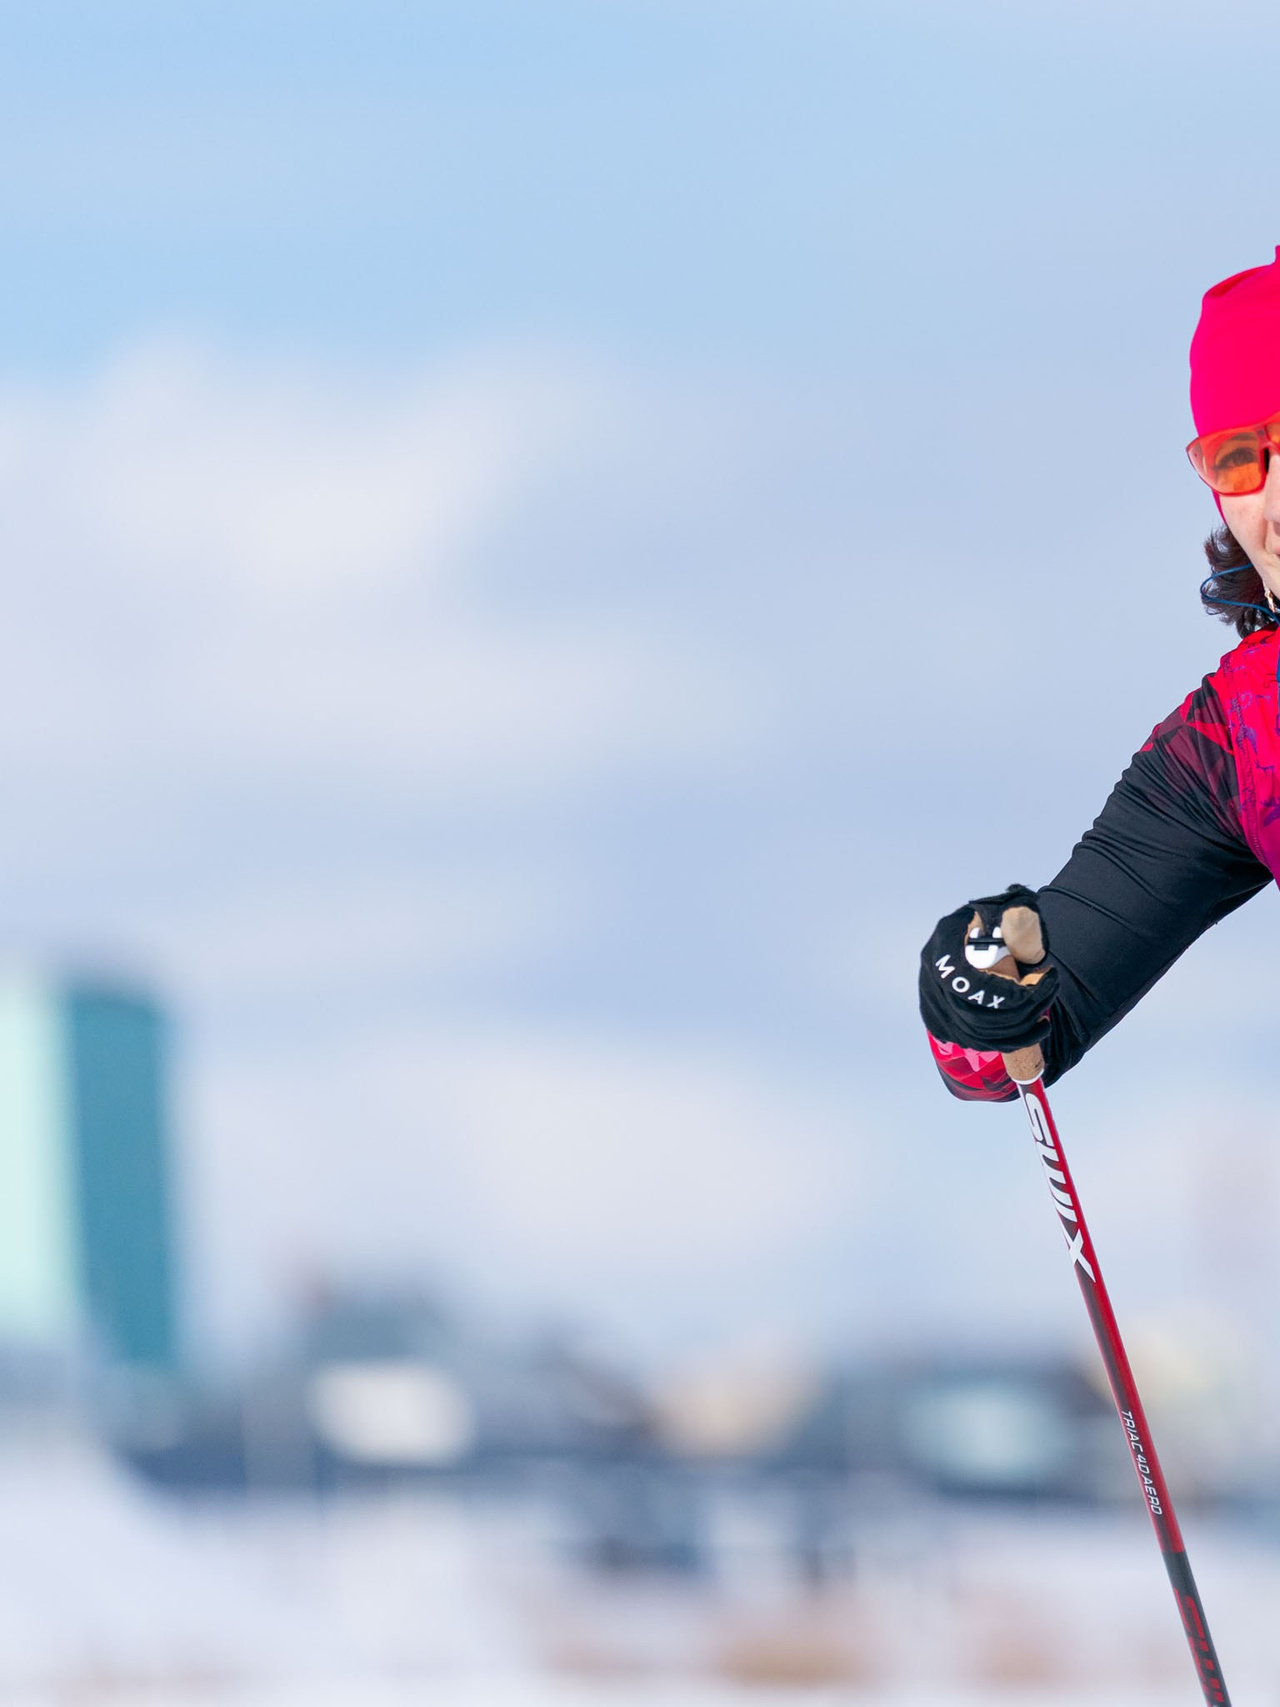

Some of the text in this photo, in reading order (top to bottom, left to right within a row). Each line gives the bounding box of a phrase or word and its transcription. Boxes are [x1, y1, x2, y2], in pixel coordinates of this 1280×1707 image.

[935, 953, 1006, 1010] MOAX
[1121, 1409, 1144, 1454] TRIAC
[1141, 1473, 1163, 1516] AERO
